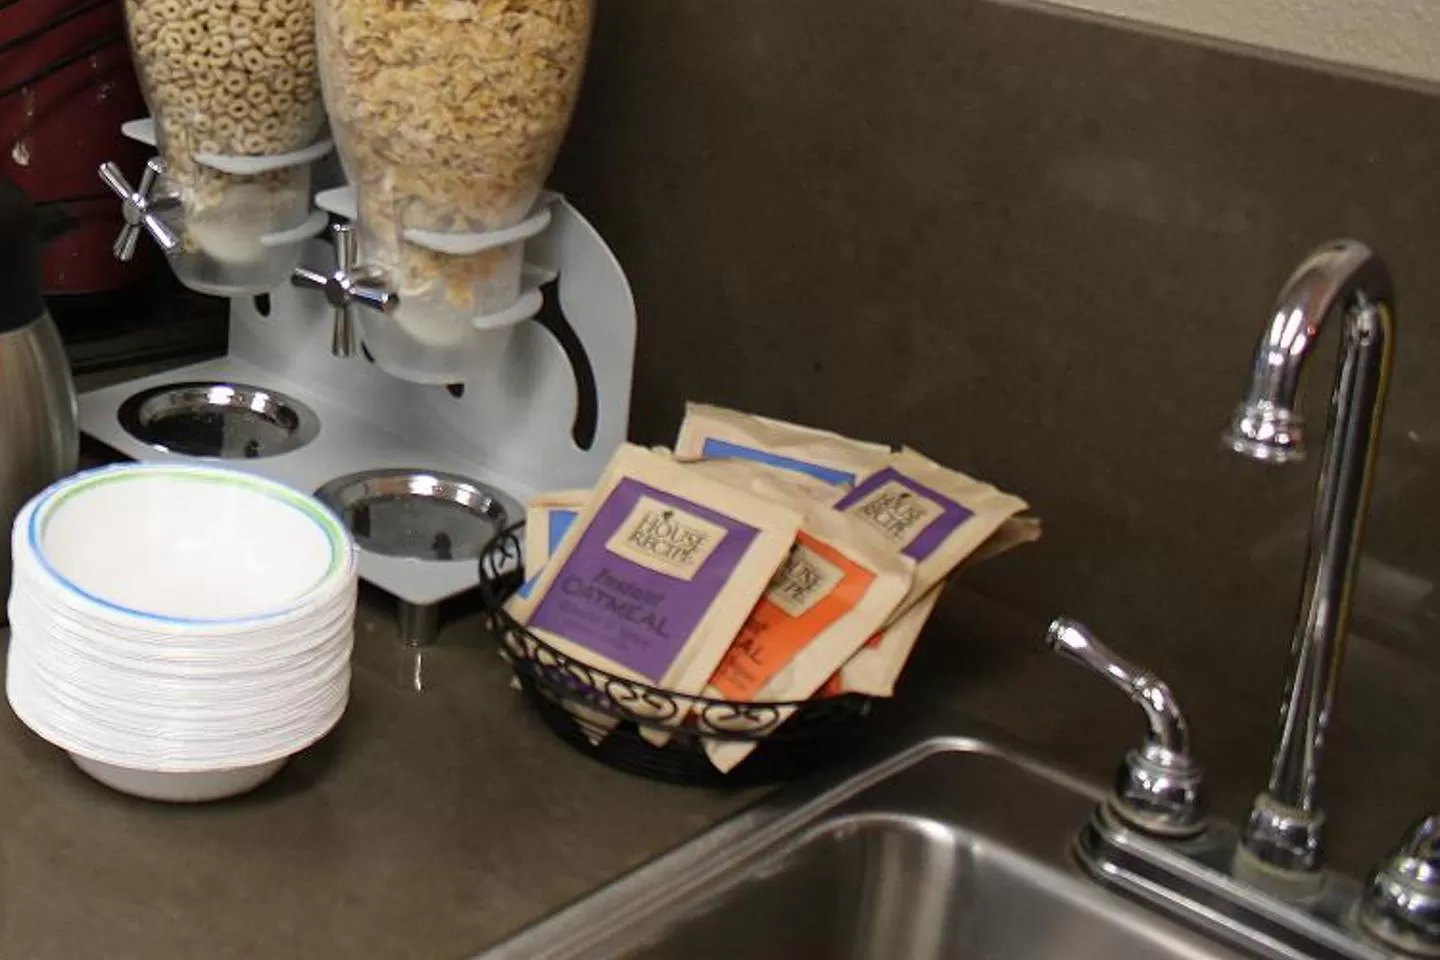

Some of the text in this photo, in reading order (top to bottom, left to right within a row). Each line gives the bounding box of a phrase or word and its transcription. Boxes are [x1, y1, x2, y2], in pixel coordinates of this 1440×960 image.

[626, 528, 701, 564] RECIPE
[638, 510, 709, 548] HOUSE
[561, 574, 672, 639] OATMEAL
